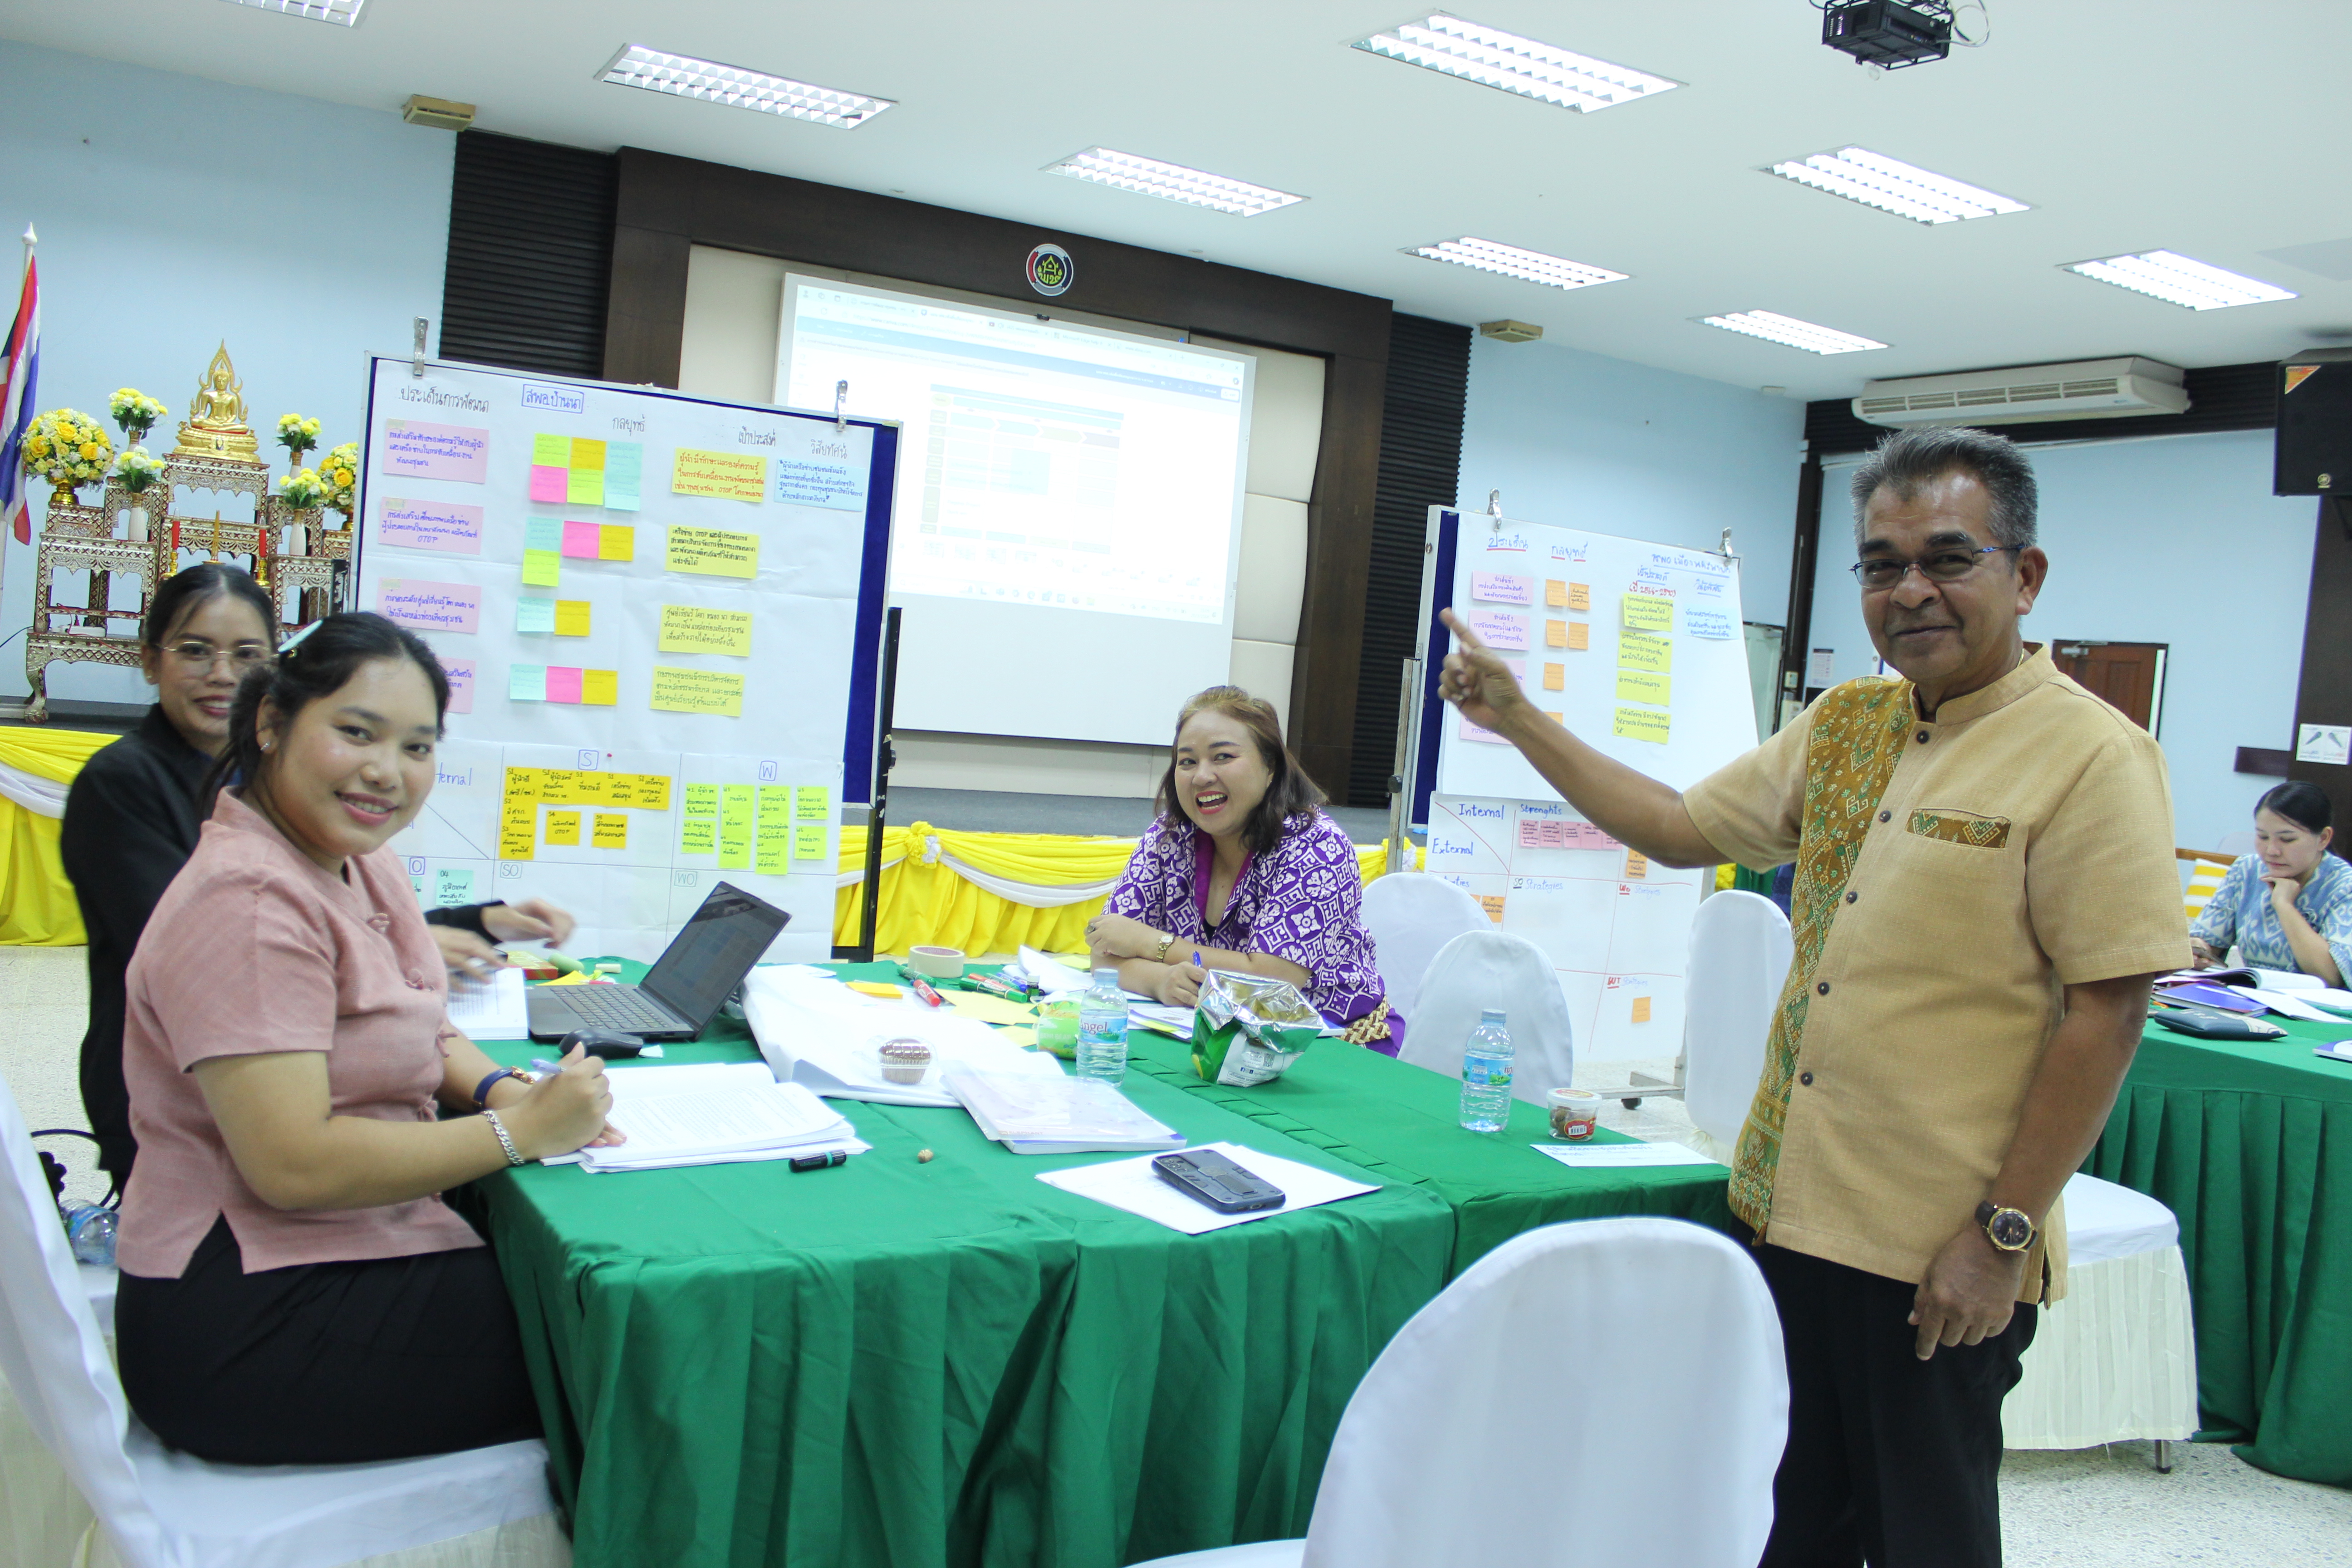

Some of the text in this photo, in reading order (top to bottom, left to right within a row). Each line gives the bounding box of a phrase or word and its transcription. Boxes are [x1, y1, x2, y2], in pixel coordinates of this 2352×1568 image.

[612, 414, 646, 436] กลยุทธ์
[581, 752, 592, 767] S
[436, 762, 472, 786] ternal
[763, 765, 773, 779] W
[1432, 838, 1474, 856] External
[502, 864, 519, 877] SO
[1513, 878, 1523, 886] SO
[1079, 1019, 1107, 1035] Angel
